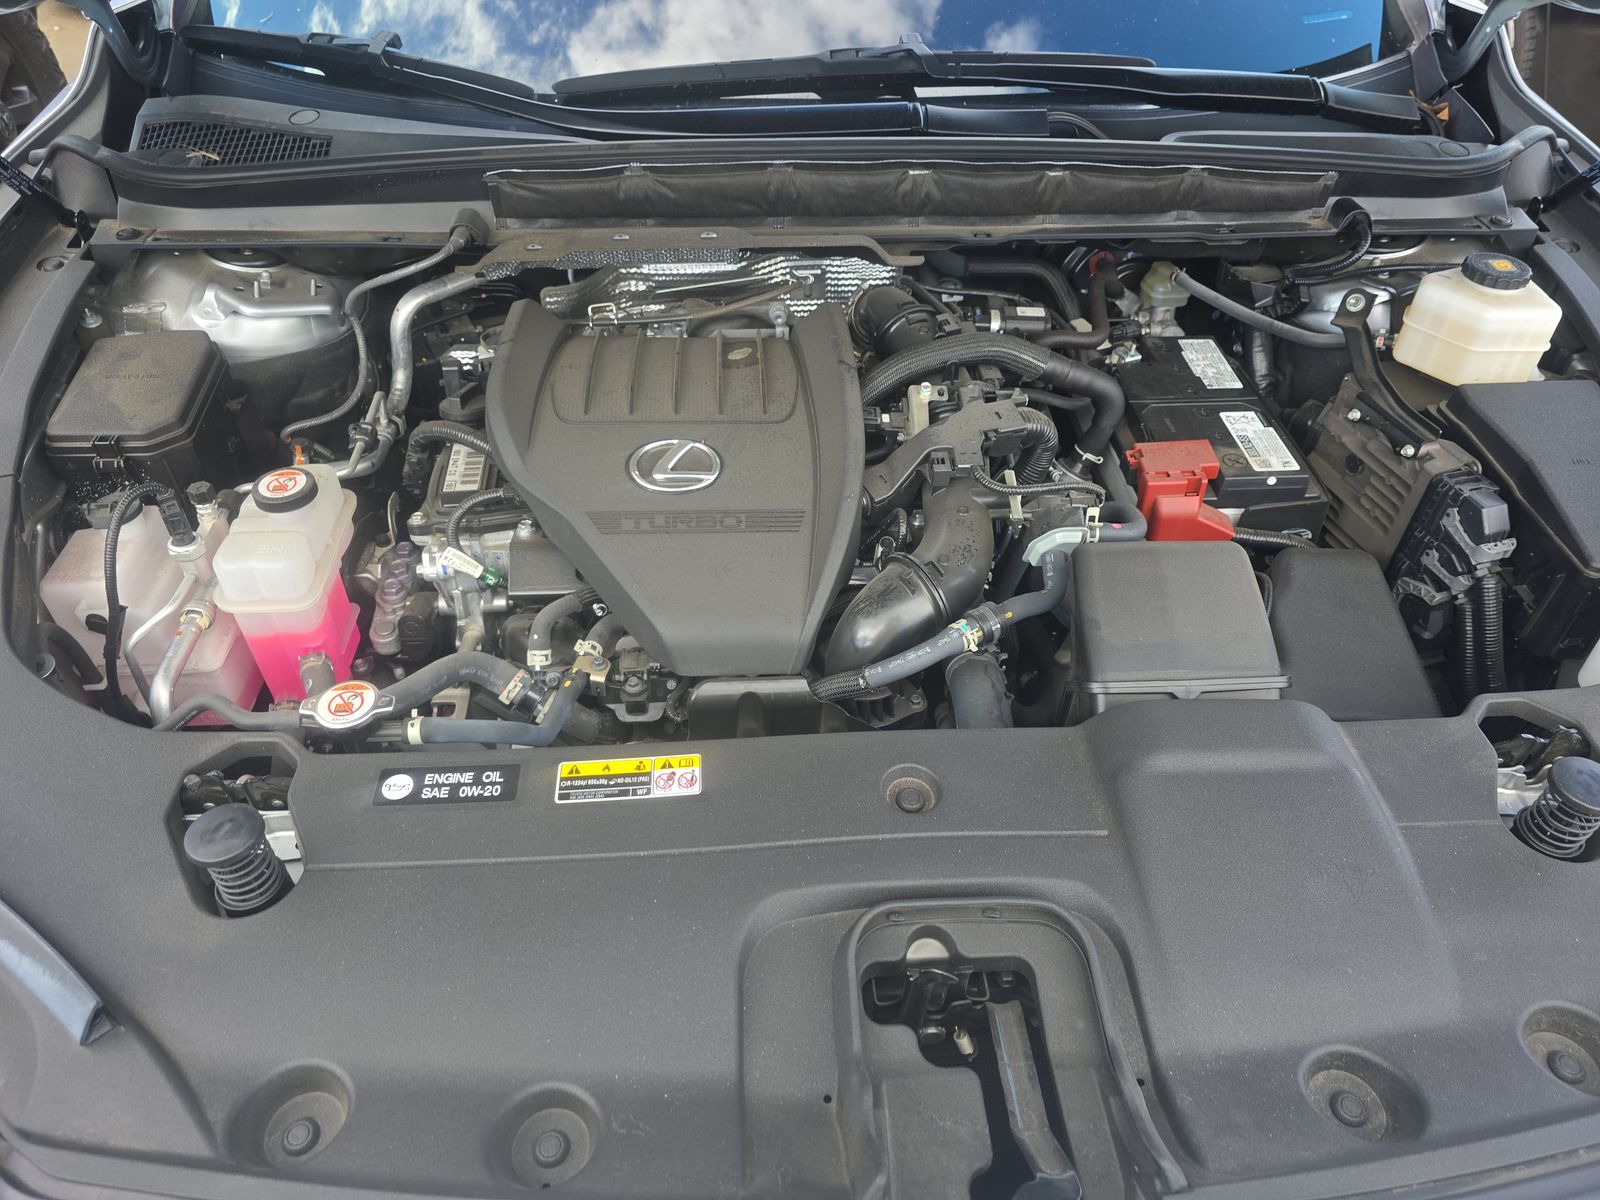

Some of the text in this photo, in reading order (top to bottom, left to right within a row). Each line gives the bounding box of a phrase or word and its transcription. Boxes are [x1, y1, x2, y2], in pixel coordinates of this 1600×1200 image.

[622, 515, 743, 530] TURBO
[424, 771, 504, 785] ENGINE OIL
[421, 785, 501, 799] SAE 0W-20
